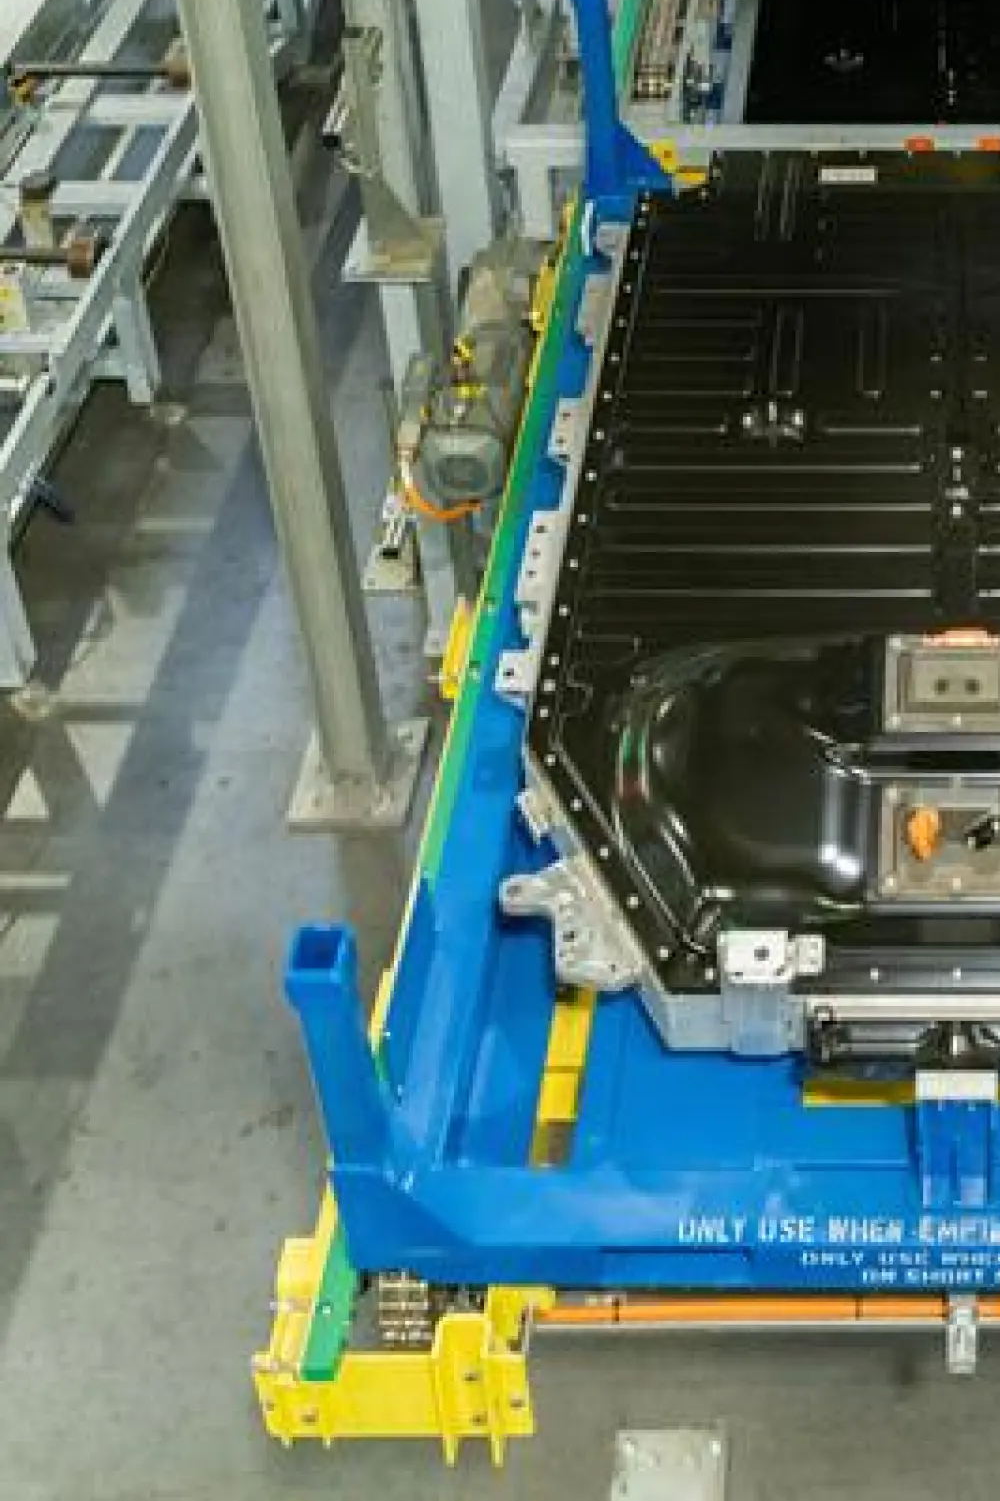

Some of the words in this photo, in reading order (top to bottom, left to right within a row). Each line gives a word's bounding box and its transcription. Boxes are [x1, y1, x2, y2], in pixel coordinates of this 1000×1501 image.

[678, 1215, 747, 1243] ONLY
[758, 1215, 815, 1243] USE
[828, 1215, 904, 1243] WHEN
[802, 1250, 864, 1267] ONLY
[877, 1250, 928, 1266] USE
